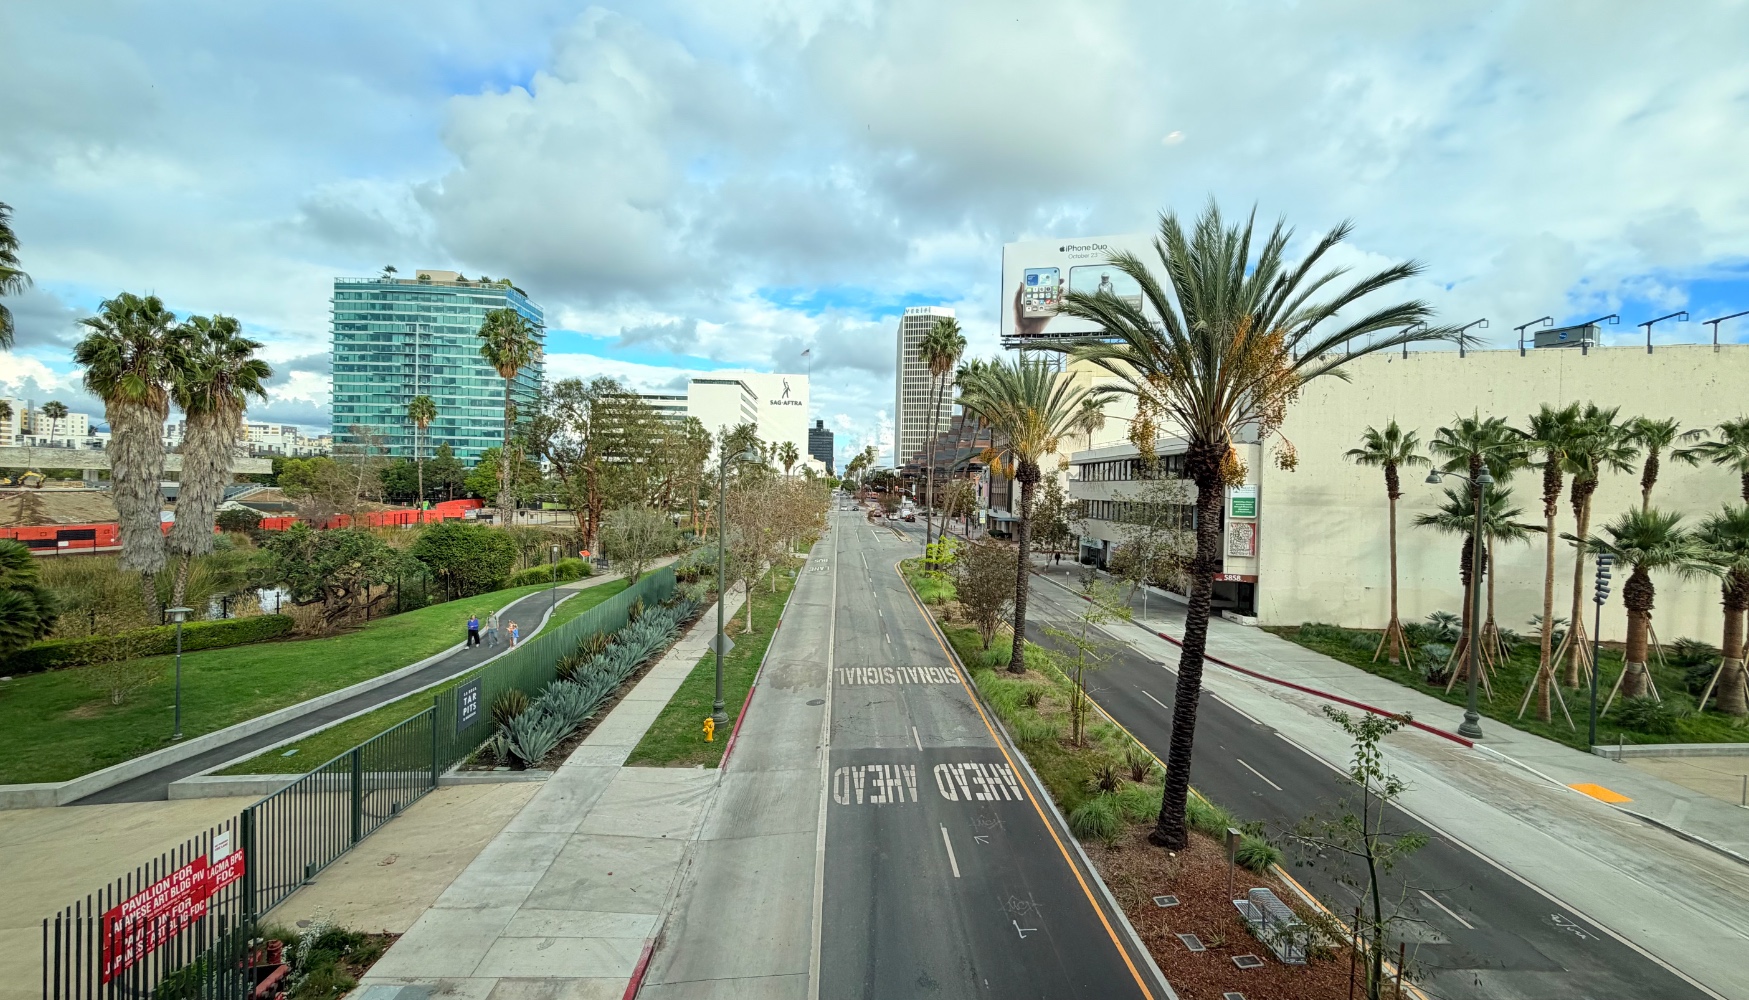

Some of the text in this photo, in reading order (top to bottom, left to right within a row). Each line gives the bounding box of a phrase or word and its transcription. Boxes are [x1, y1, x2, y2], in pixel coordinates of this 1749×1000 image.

[463, 692, 476, 706] TAR
[463, 702, 476, 716] PITS
[834, 764, 917, 805] AHEAD
[934, 763, 1023, 801] AHEAD
[207, 851, 243, 880] LACMA BPC
[216, 866, 234, 885] FDC
[122, 878, 170, 916] PAVILION
[173, 865, 193, 884] FOR
[109, 902, 152, 938] APANESE
[153, 891, 169, 910] ART
[170, 878, 191, 898] BLDG
[192, 869, 205, 885] PIV
[172, 898, 192, 918] FOR
[190, 900, 205, 917] FDC
